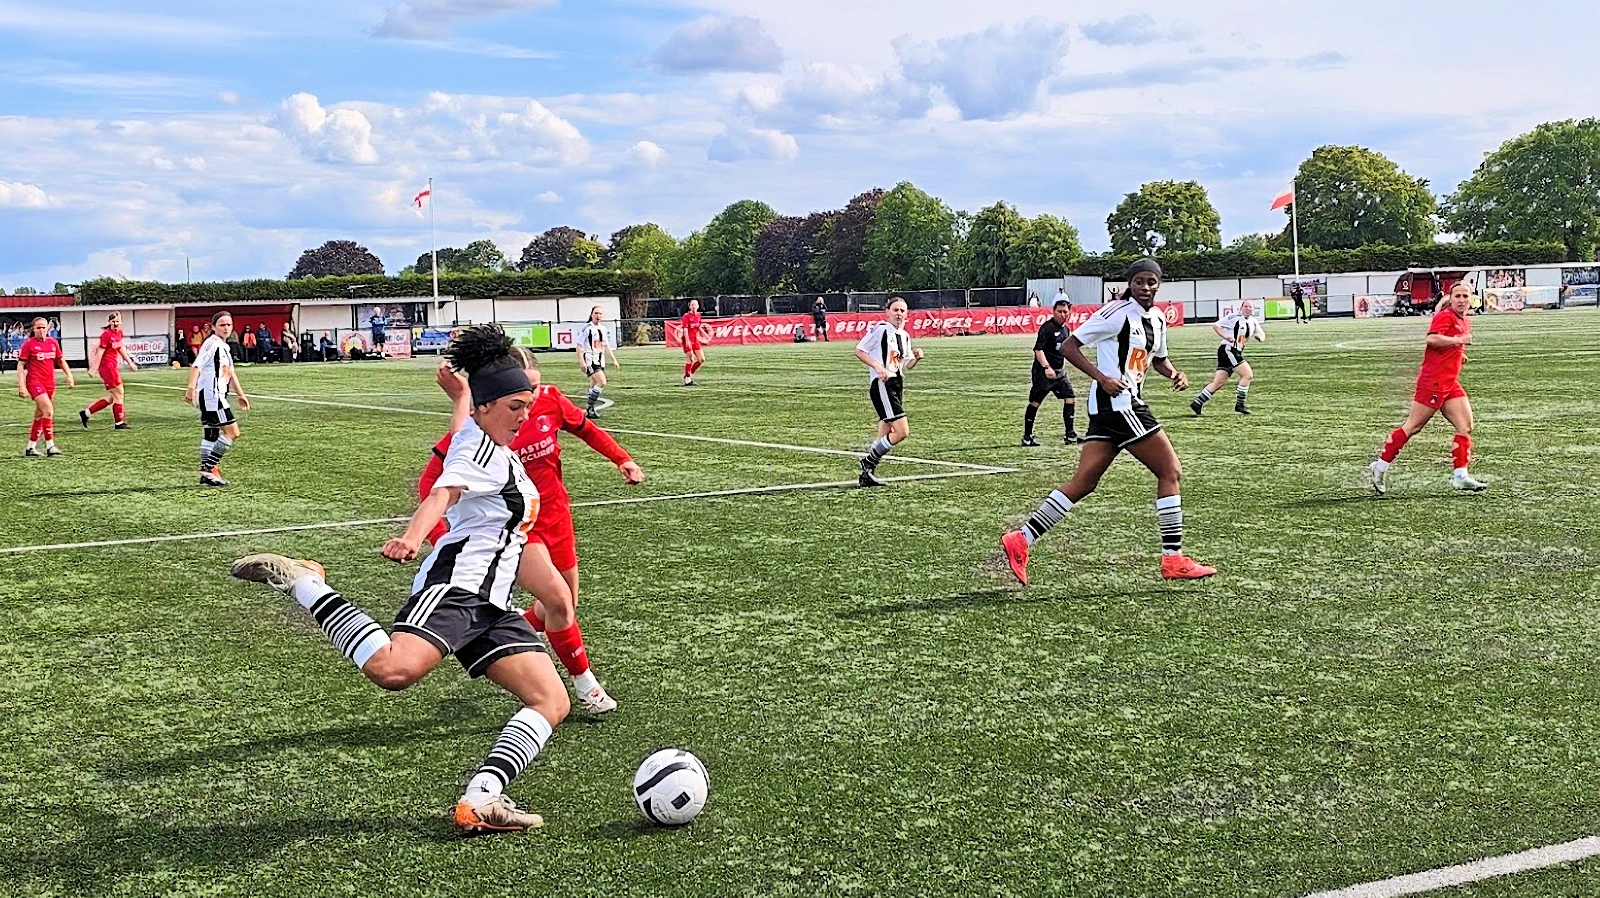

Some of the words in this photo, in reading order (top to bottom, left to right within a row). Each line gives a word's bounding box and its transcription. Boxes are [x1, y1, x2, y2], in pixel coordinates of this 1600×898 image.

[835, 319, 909, 334] BEDFT
[126, 343, 149, 351] HOME
[152, 342, 163, 351] OF
[521, 444, 555, 463] ECURED
